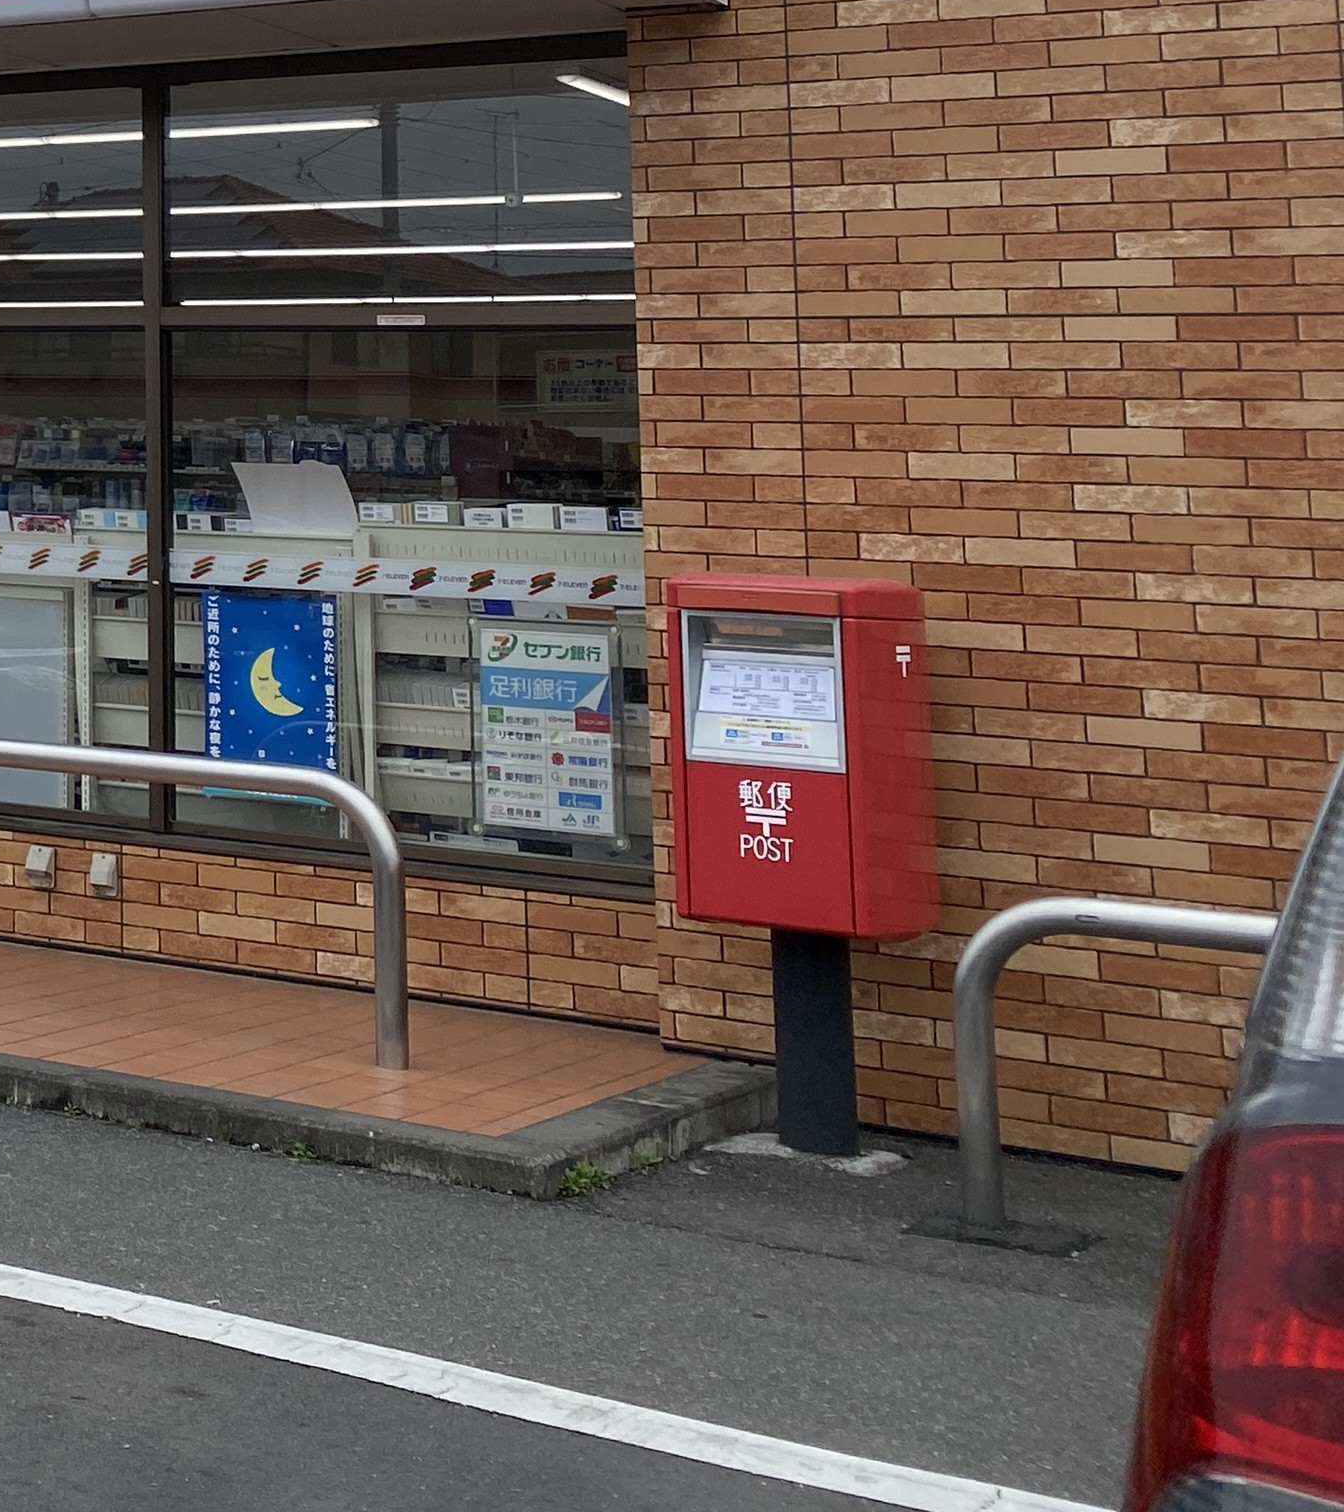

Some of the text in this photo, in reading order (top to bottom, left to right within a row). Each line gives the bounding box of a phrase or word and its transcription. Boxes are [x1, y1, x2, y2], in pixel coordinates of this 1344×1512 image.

[523, 641, 602, 662] セブン銀行
[489, 675, 577, 703] 足利銀行
[499, 729, 543, 743] りそな銀行
[504, 772, 543, 785] 東邦銀行
[568, 777, 609, 790] 群馬銀行
[738, 779, 793, 811] 郵便
[739, 833, 794, 863] POST
